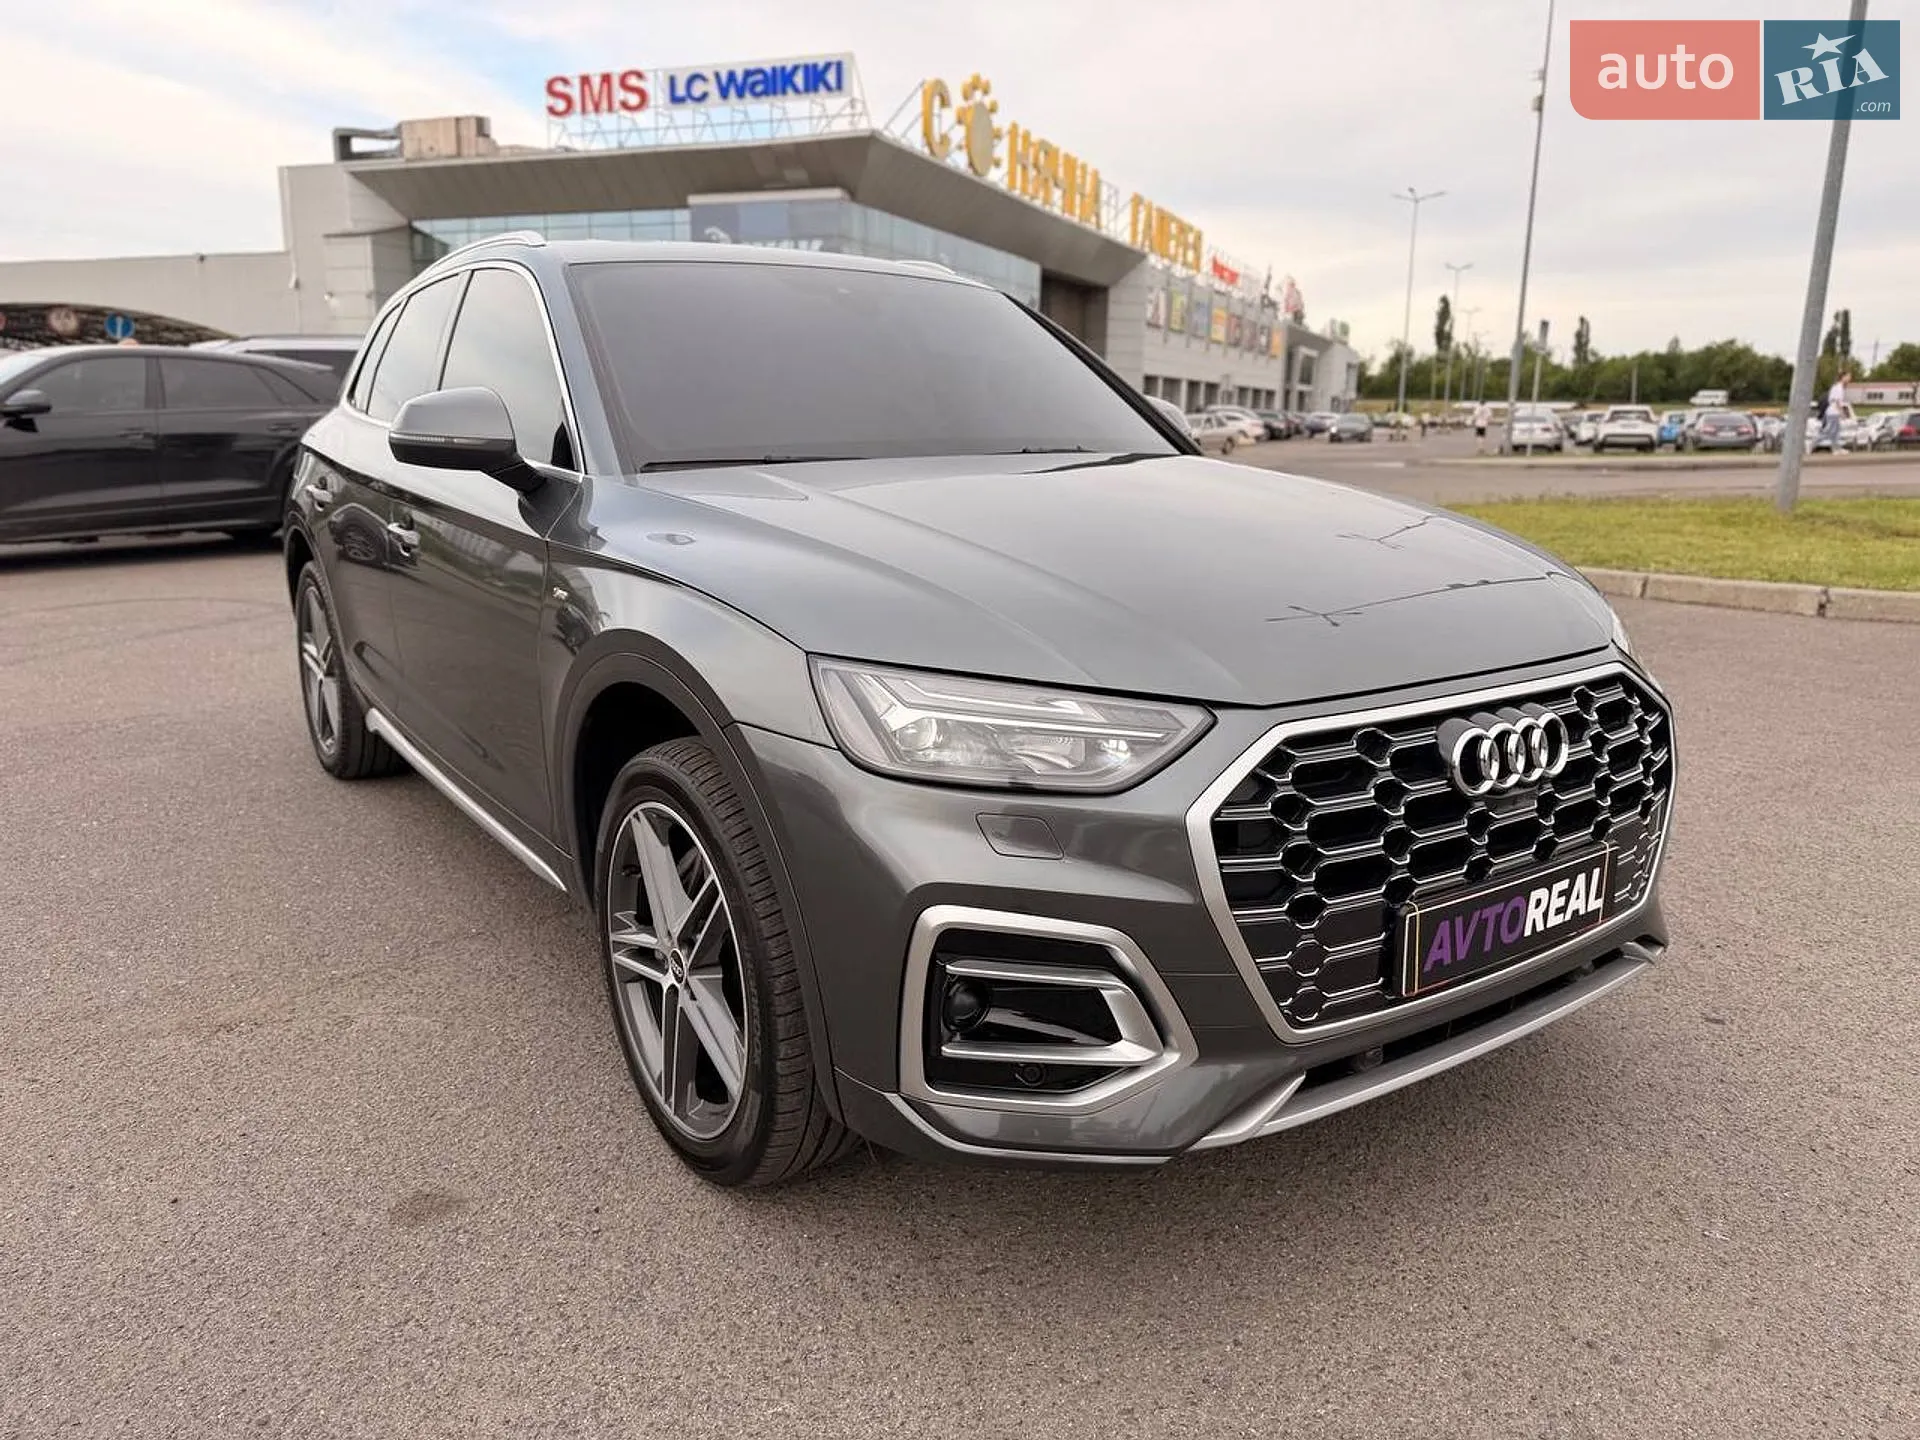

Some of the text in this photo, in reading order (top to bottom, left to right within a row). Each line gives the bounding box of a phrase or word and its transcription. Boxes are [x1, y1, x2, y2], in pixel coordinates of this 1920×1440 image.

[545, 69, 649, 117] SMS
[667, 73, 709, 106] LC
[1423, 867, 1603, 972] AVTOREAL
